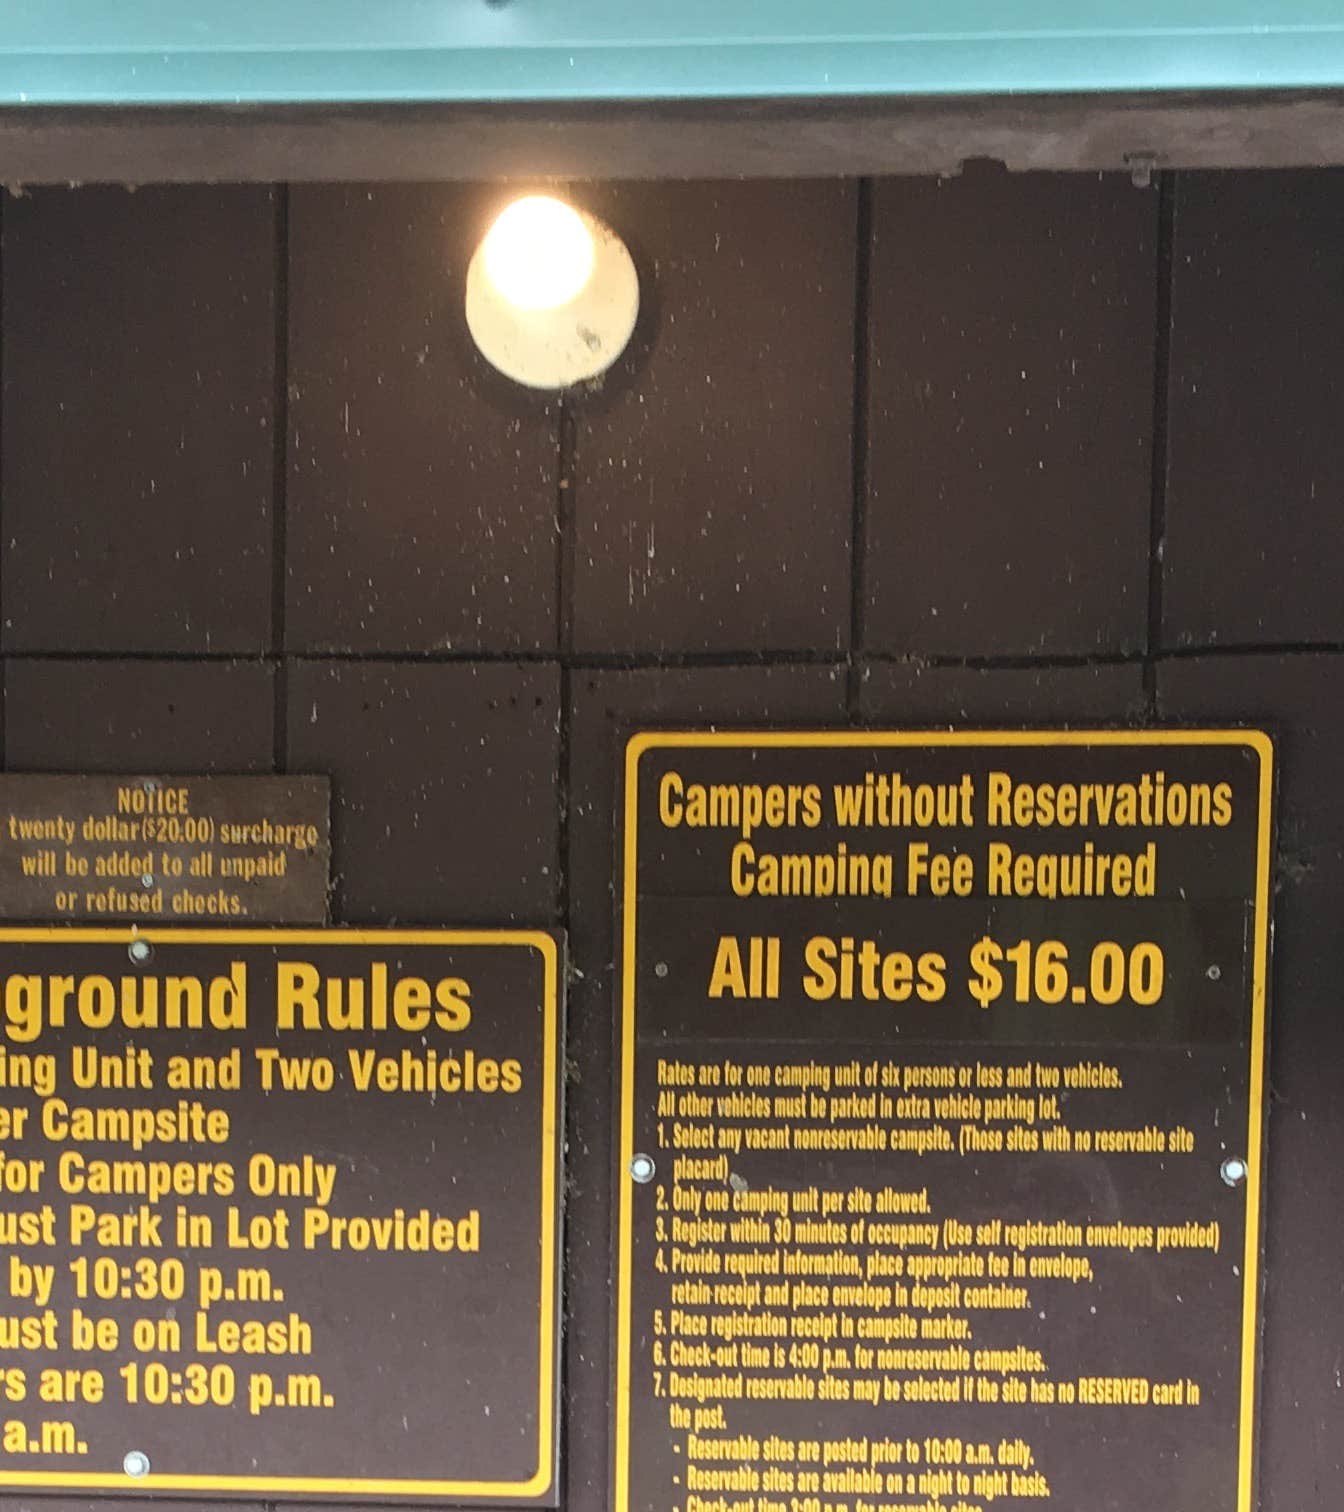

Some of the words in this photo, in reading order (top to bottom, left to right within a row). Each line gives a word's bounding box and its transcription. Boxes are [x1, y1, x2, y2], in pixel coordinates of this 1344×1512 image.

[118, 788, 188, 815] NOTICE
[659, 772, 821, 839] Campers
[834, 772, 974, 827] without
[988, 771, 1232, 826] Reservations
[8, 814, 76, 845] twenty
[220, 820, 318, 850] surcharge
[22, 850, 56, 876] will
[65, 851, 89, 876] be
[95, 851, 153, 877] added
[162, 852, 183, 877] to
[189, 851, 213, 877] all
[220, 851, 287, 881] unpaid
[731, 841, 893, 897] Camping
[908, 842, 973, 896] Fee
[988, 842, 1156, 898] Required
[55, 891, 78, 911] or
[86, 886, 163, 913] refused
[708, 936, 780, 998] All
[803, 936, 946, 1002] Sites
[968, 937, 1164, 1008] $16.00
[277, 961, 471, 1031] Rules
[72, 1045, 153, 1089] Unit
[167, 1048, 241, 1090] and
[255, 1048, 335, 1091] Two
[349, 1048, 522, 1093] Vehicles
[657, 1059, 695, 1086] Rates
[698, 1065, 721, 1086] are
[724, 1060, 743, 1086] for
[746, 1065, 771, 1087] one
[774, 1060, 831, 1092] camping
[834, 1060, 861, 1087] unit
[864, 1061, 878, 1087] of
[881, 1060, 900, 1087] six
[903, 1066, 956, 1093] persons
[958, 1067, 973, 1088] or
[976, 1061, 1003, 1088] less
[1006, 1061, 1032, 1088] and
[1035, 1062, 1060, 1088] two
[42, 1098, 229, 1150] Campsite
[59, 1151, 234, 1204] Campers
[249, 1153, 336, 1206] Only
[673, 1153, 729, 1185] placard)
[70, 1204, 162, 1247] Park
[176, 1205, 212, 1248] in
[228, 1206, 289, 1250] Lot
[304, 1208, 479, 1252] Provided
[10, 1255, 55, 1306] by
[69, 1256, 184, 1300] 10:30
[200, 1268, 284, 1309] p.m.
[72, 1308, 119, 1351] be
[133, 1318, 180, 1353] on
[196, 1311, 311, 1355] Leash
[670, 1341, 738, 1367] Check-out
[741, 1342, 770, 1368] time
[773, 1342, 786, 1369] is
[854, 1343, 874, 1370] for
[877, 1344, 971, 1371] nonreservable
[39, 1369, 104, 1403] are
[119, 1362, 235, 1406] 10:30
[248, 1373, 334, 1415] p.m.
[3, 1420, 88, 1454] a.m.
[669, 1402, 691, 1429] the
[687, 1436, 760, 1461] Reservable
[762, 1437, 795, 1462] sites
[797, 1441, 820, 1462] are
[823, 1438, 868, 1467] posted
[871, 1438, 903, 1471] prior
[906, 1439, 920, 1464] to
